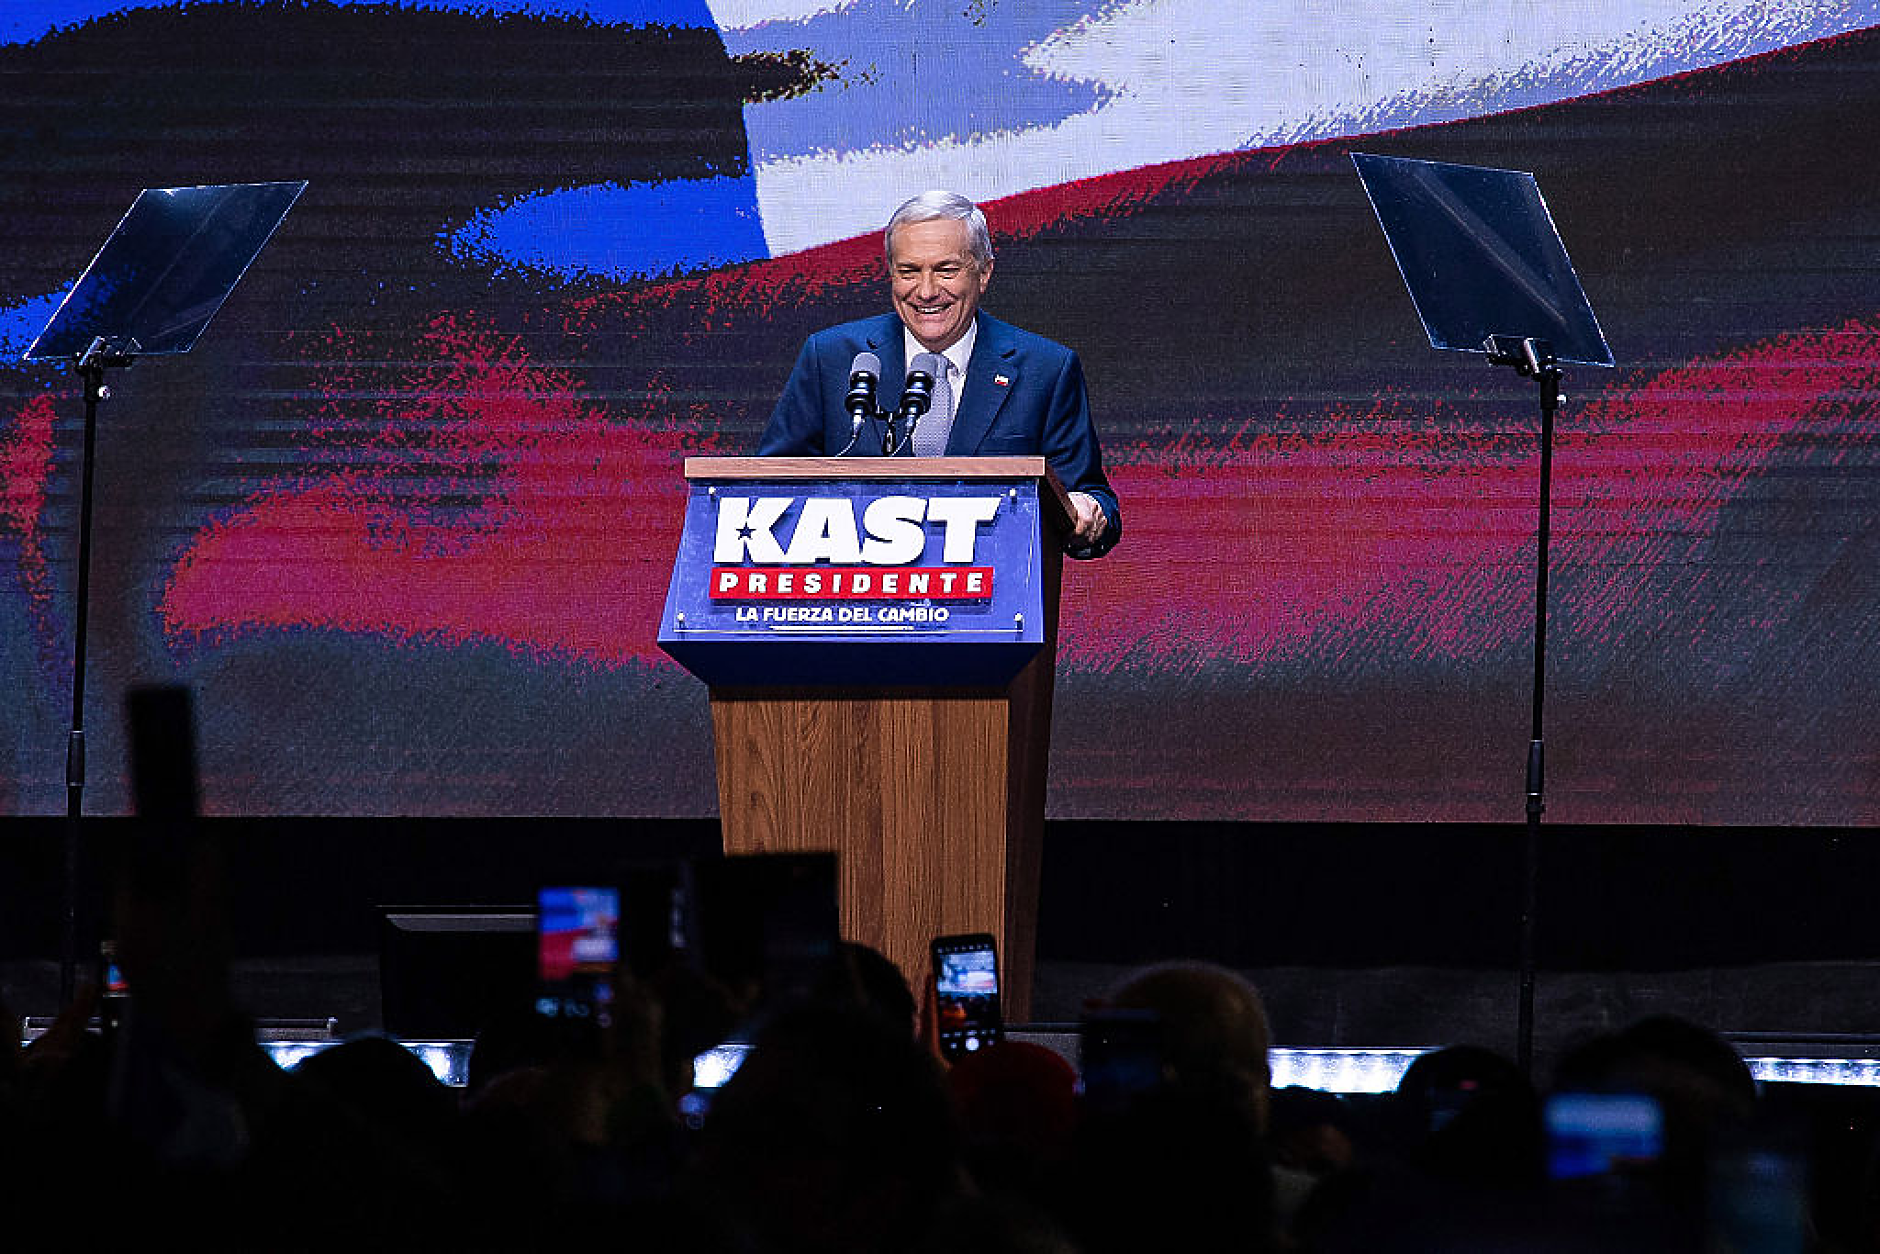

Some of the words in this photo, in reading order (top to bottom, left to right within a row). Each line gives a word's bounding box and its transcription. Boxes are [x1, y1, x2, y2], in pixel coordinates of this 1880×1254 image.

[713, 495, 1002, 565] KAST
[719, 572, 984, 594] PRESIDENTE
[735, 607, 762, 622] LA
[763, 607, 833, 622] FUERZA
[838, 607, 873, 622] DEL
[877, 606, 950, 622] CAMBIO
